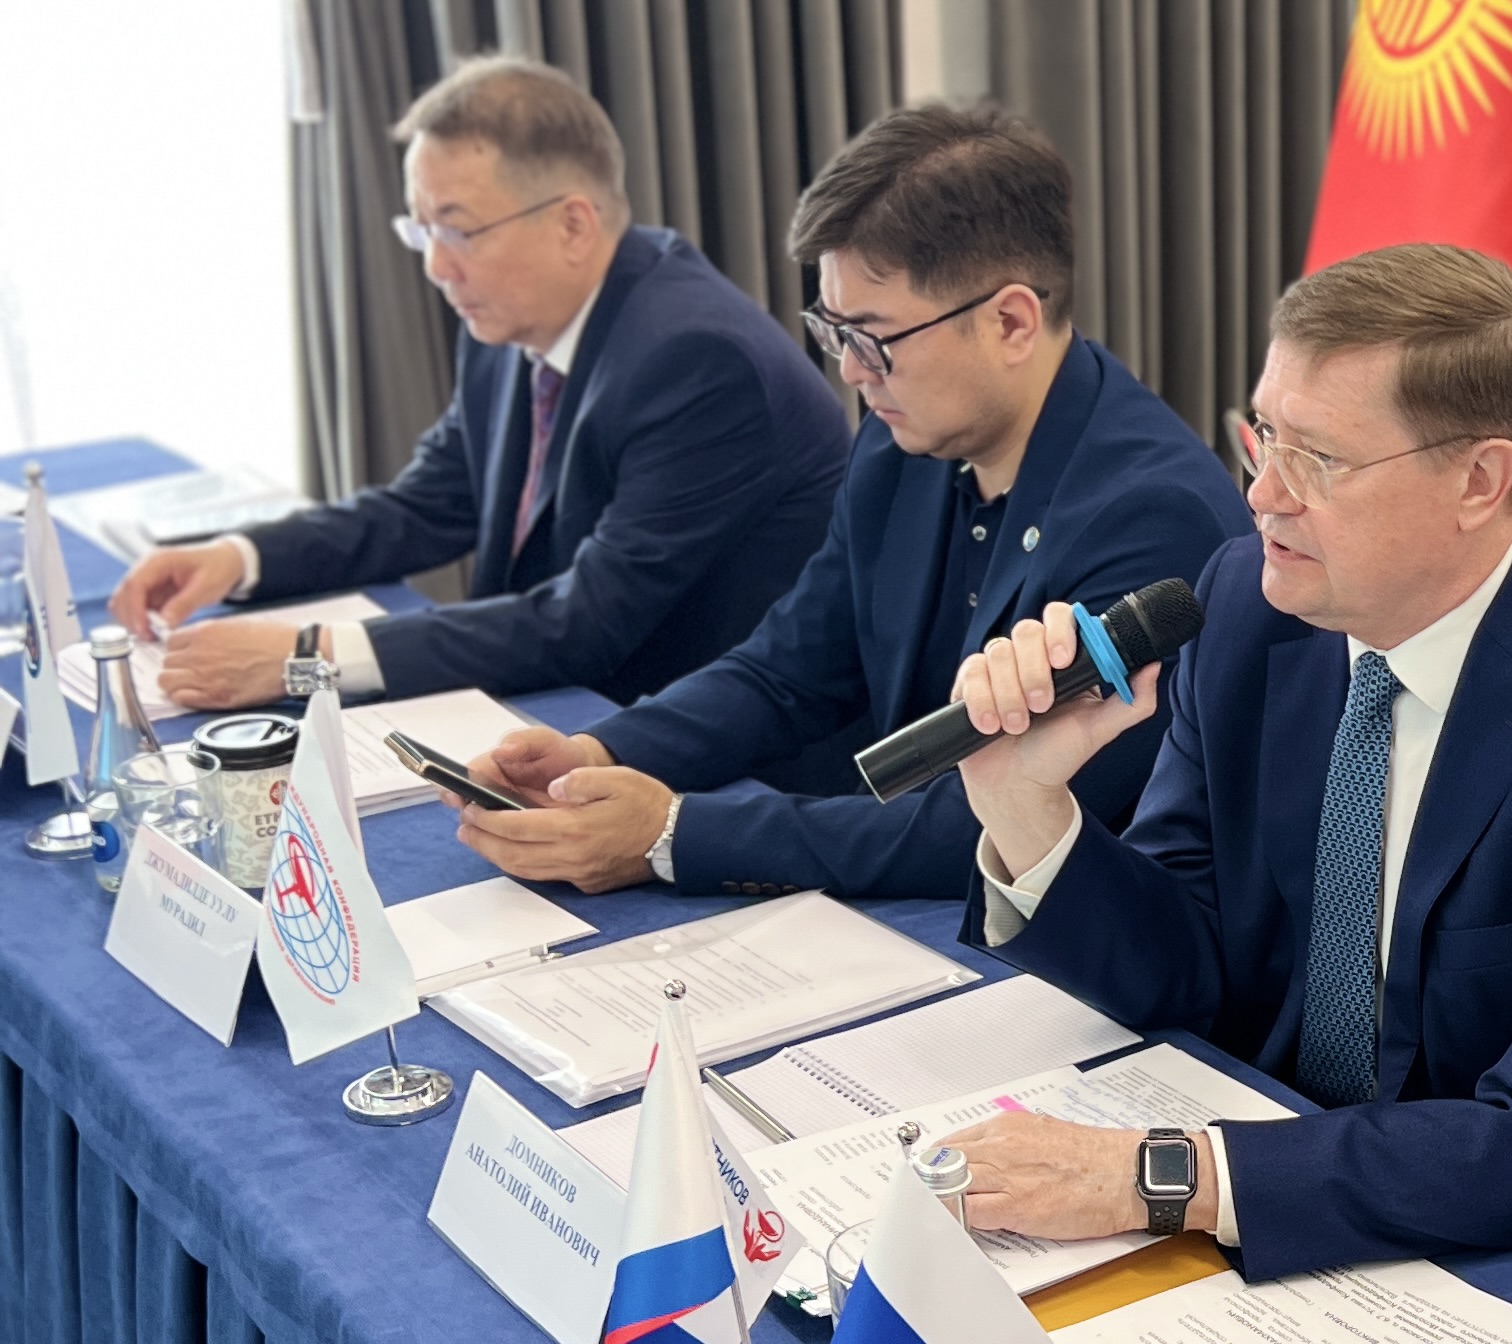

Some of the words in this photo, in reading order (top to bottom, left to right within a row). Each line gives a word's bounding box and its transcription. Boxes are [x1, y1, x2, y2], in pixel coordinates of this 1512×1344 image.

[464, 1142, 533, 1207] АНАТОЛИЙ
[528, 1195, 601, 1267] ИВАНОВИЧ
[504, 1135, 577, 1204] ДОМНИКОВ
